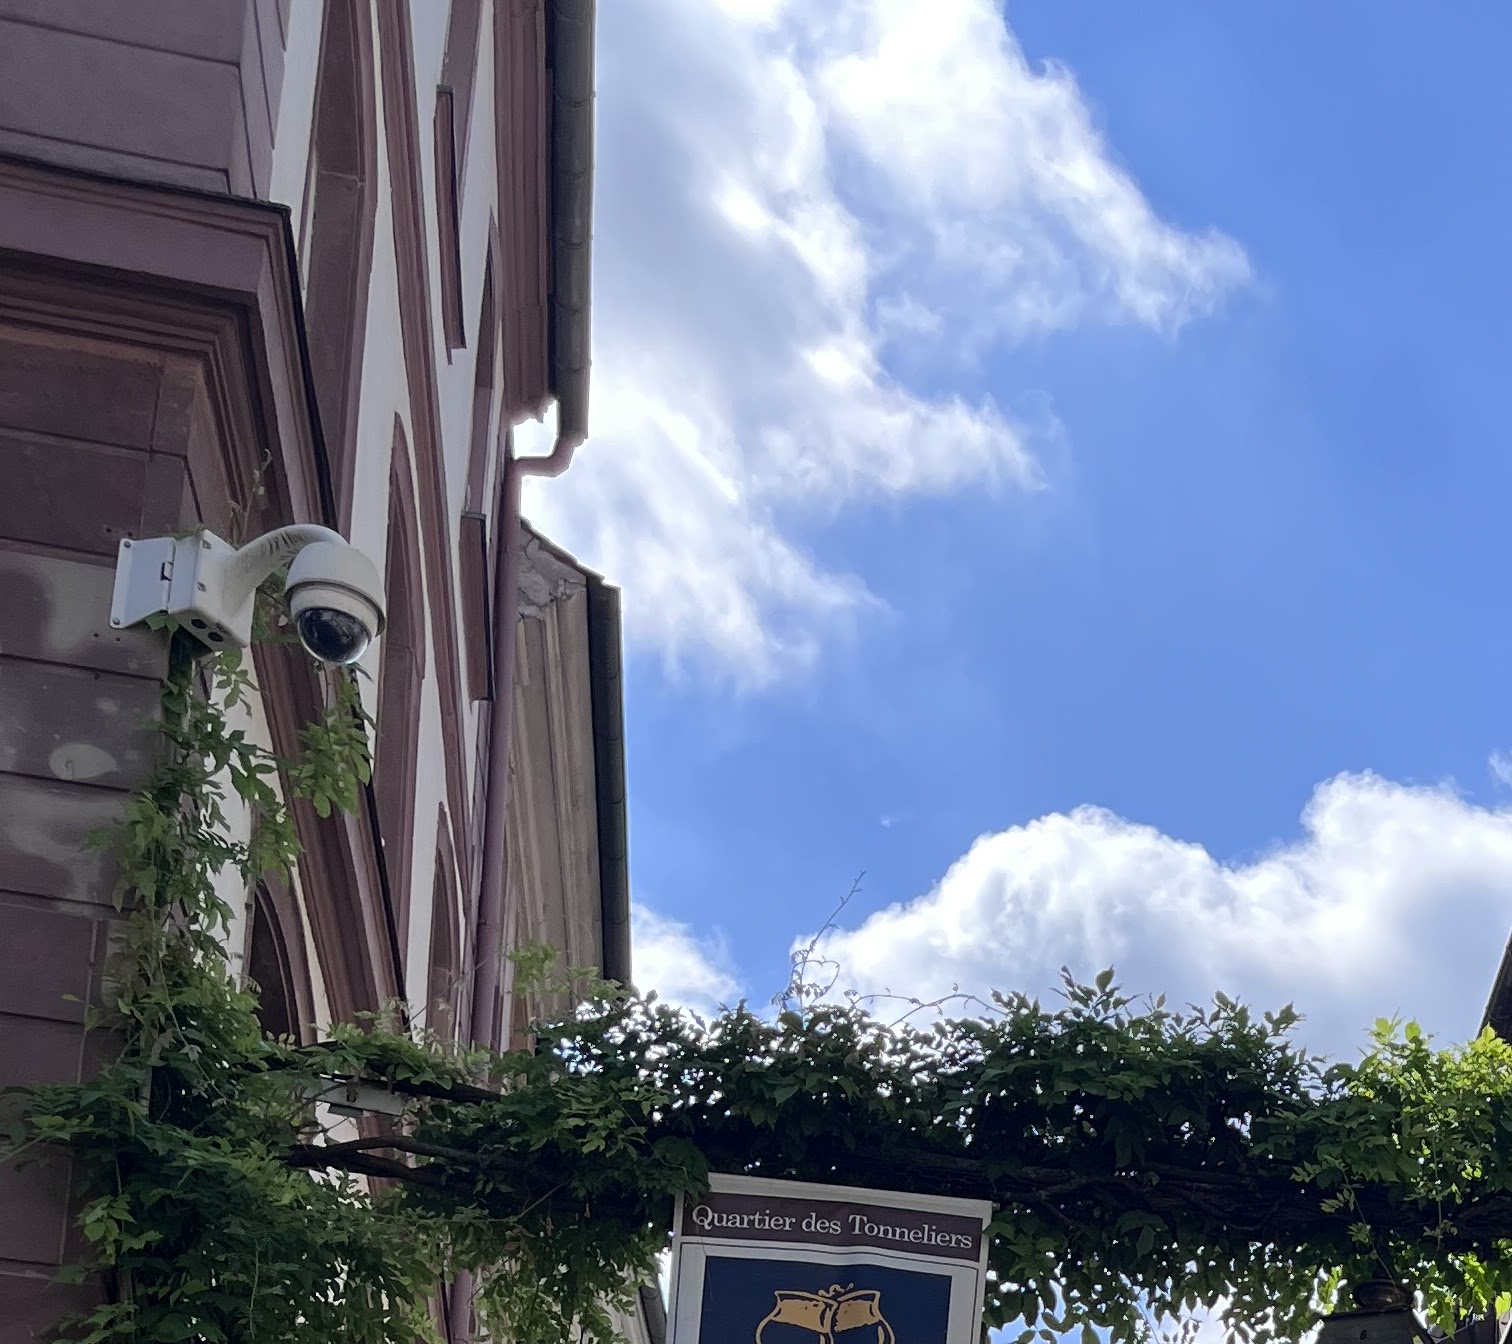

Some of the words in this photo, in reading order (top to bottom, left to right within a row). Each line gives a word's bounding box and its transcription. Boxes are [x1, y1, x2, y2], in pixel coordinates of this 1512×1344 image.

[692, 1204, 795, 1232] Quartier
[801, 1210, 842, 1236] des
[848, 1214, 973, 1250] Tonneliers
